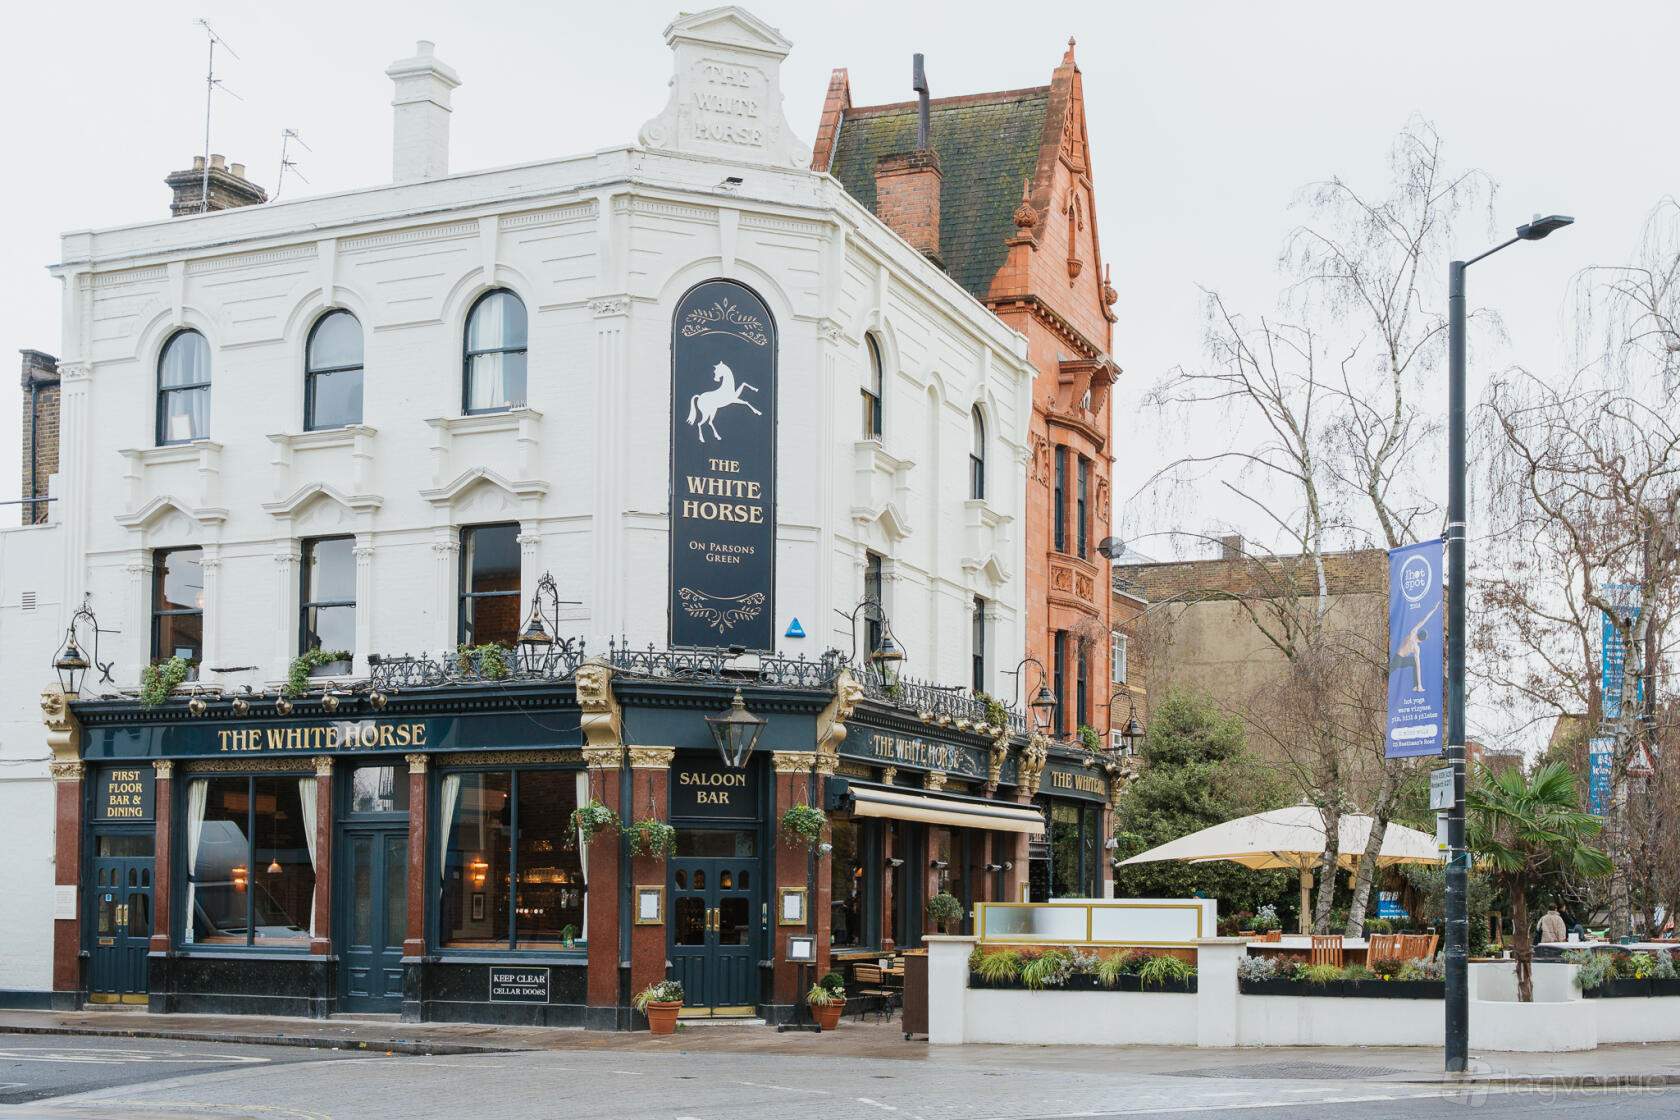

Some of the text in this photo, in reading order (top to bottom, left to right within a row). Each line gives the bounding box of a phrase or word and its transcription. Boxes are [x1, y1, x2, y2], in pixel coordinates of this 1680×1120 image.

[703, 65, 750, 88] THE
[693, 91, 758, 118] WHITE
[695, 121, 763, 147] HORSE
[709, 458, 740, 473] THE
[686, 475, 762, 500] WHITE
[682, 499, 764, 525] HORSE
[710, 542, 755, 555] PARSONS
[705, 552, 740, 564] GREEN
[1409, 568, 1426, 579] hot
[1405, 578, 1426, 591] spot
[218, 723, 427, 751] THE WHITE HORSE
[873, 734, 960, 769] THE WHITE HORSE
[112, 771, 140, 781] FIRST
[680, 772, 746, 787] SALOON
[1050, 770, 1073, 789] THE
[108, 783, 143, 793] FLOOR
[109, 795, 142, 805] BAR &
[697, 791, 730, 804] BAR
[107, 807, 143, 817] DINING
[493, 974, 546, 984] KEEP CLEAR
[493, 987, 546, 996] CELLAR DOORS
